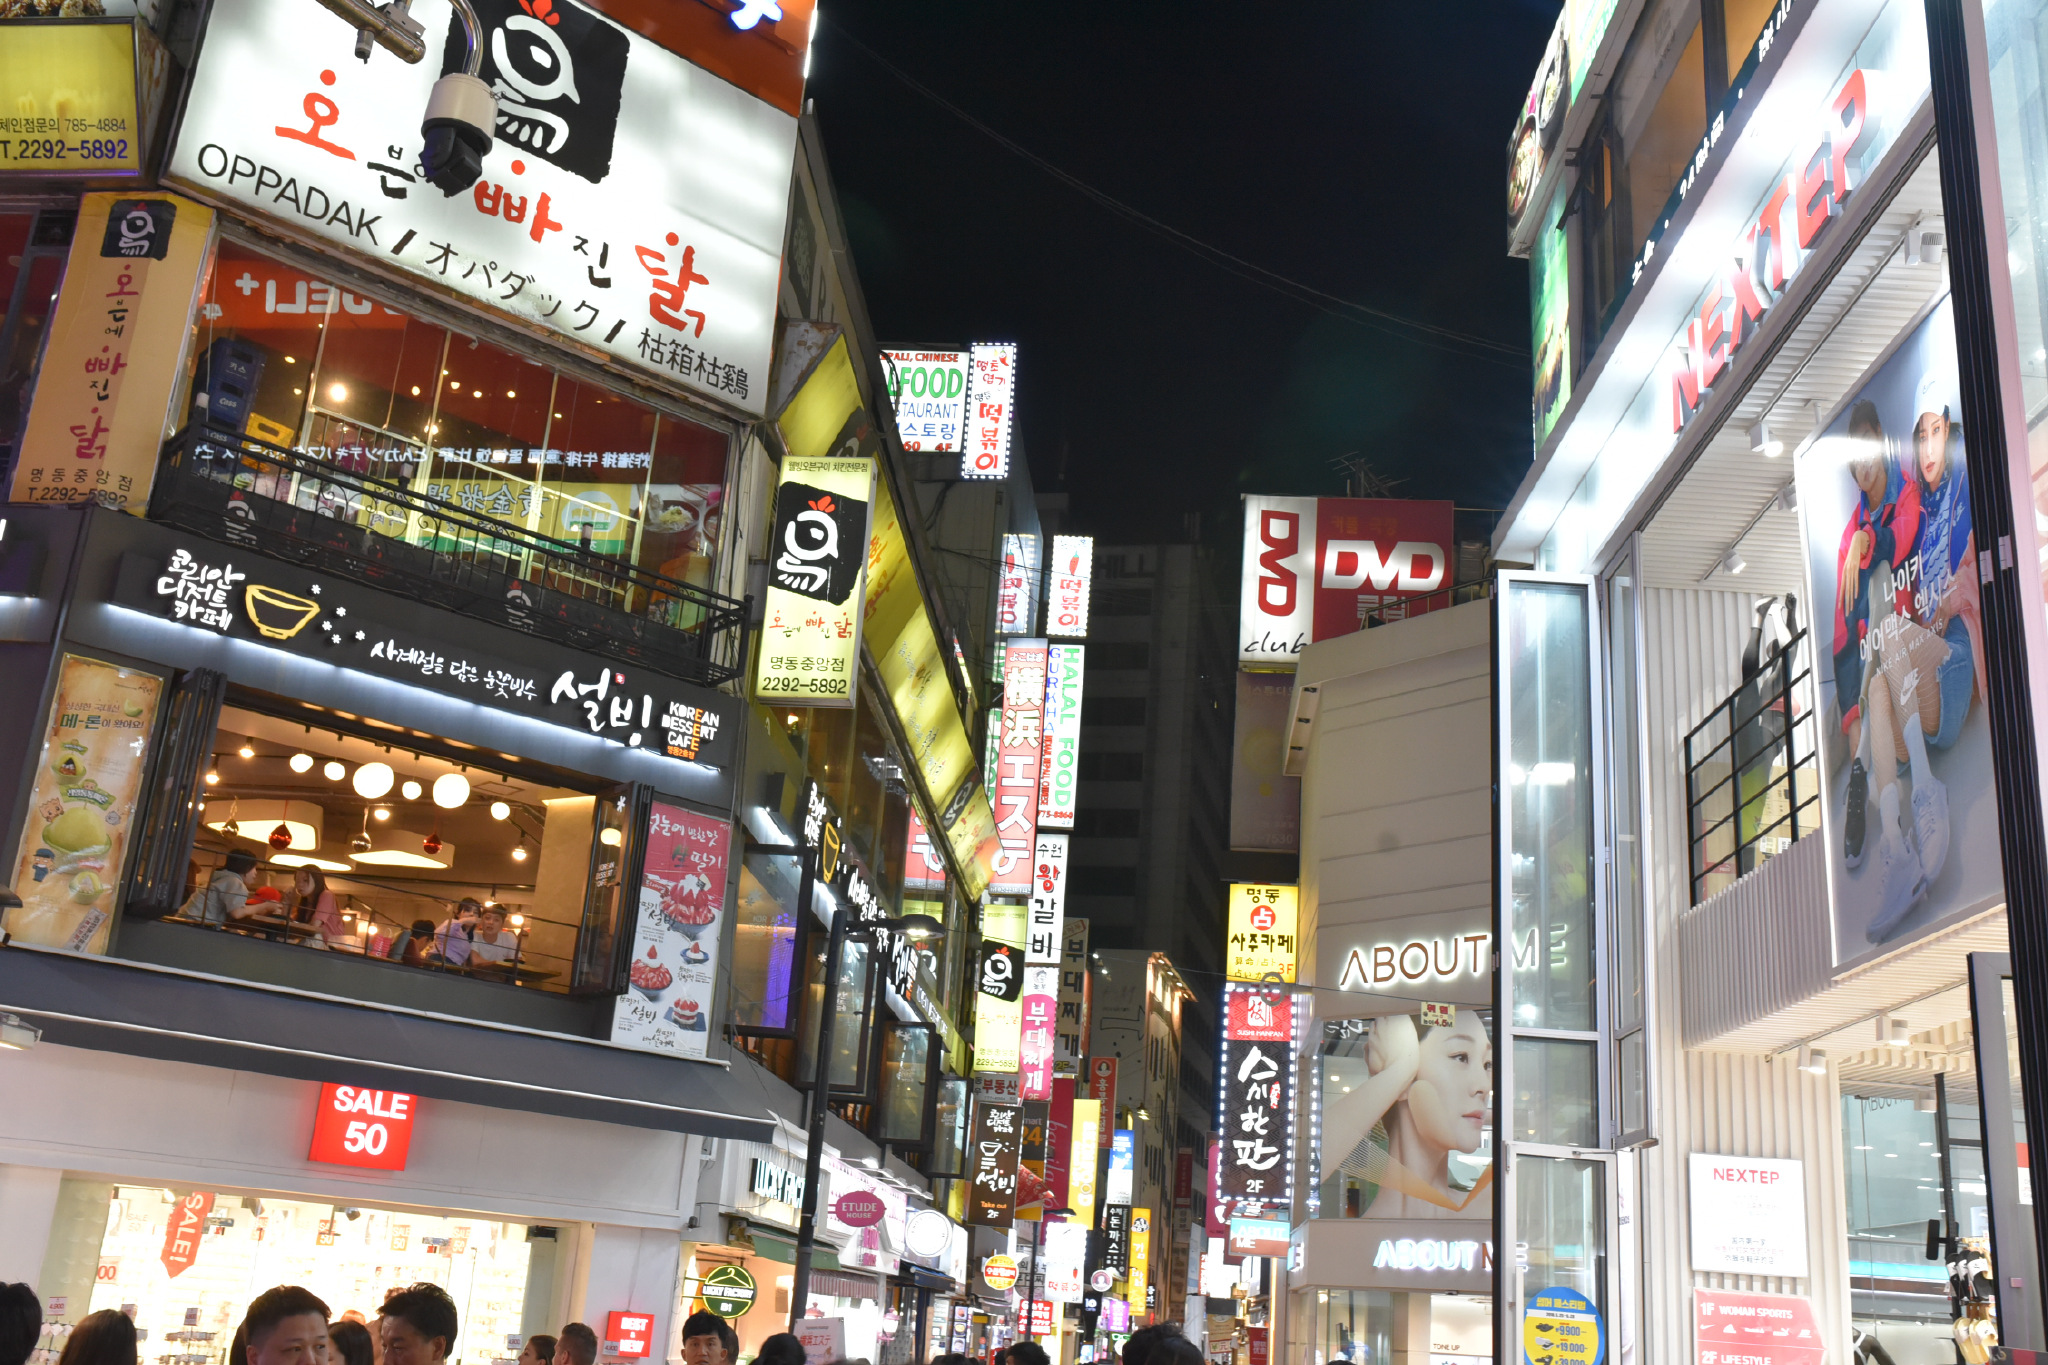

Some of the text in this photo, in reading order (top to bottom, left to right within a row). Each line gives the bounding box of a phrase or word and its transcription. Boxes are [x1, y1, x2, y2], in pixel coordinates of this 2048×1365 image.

[64, 119, 127, 133] 785-4884
[0, 139, 128, 161] T.2292-5892
[197, 143, 383, 246] OPPADAK
[1672, 69, 1867, 434] NEXTEP
[425, 241, 600, 332] オパダック
[915, 353, 959, 362] CHINESE
[975, 402, 1003, 471] 떡볶이
[168, 548, 246, 591] 코리안
[1258, 510, 1300, 617] DVD
[1321, 539, 1446, 591] DVD
[1882, 549, 1924, 604] 나이키
[157, 577, 228, 609] 디저트
[174, 599, 233, 631] 카페
[1859, 569, 1957, 662] 에어맥스 엑시스
[1244, 631, 1309, 654] club
[370, 639, 444, 675] 사계절을
[450, 660, 480, 683] 담은
[770, 656, 844, 672] 명동중앙점
[762, 677, 847, 694] 2292-5892
[1043, 647, 1061, 733] GURKHA
[550, 668, 653, 747] 설빙
[669, 701, 720, 727] KOREAN
[661, 713, 718, 740] DESSERT
[668, 731, 700, 751] CAFE
[1055, 648, 1080, 807] HALAL FOOD
[1037, 843, 1062, 859] 수원
[1032, 864, 1060, 959] 왕갈비
[1247, 888, 1280, 904] 명동
[1230, 933, 1294, 954] 사주카페
[1278, 963, 1294, 975] 3F
[1340, 934, 1488, 988] ABOUT
[1058, 938, 1084, 1058] 부대찌개
[1022, 1002, 1049, 1091] 부대찌개
[976, 1058, 1017, 1068] 2292-5892
[982, 1079, 1018, 1094] 부동산
[333, 1086, 410, 1120] SALE
[344, 1122, 388, 1156] 50
[1246, 1180, 1265, 1192] 2F
[1713, 1168, 1780, 1184] NEXTEP
[841, 1203, 878, 1212] ETUDE
[987, 1209, 999, 1219] 2F
[169, 1193, 204, 1264] SALE!
[1373, 1239, 1480, 1273] ABOUT
[621, 1317, 649, 1331] BEST
[1700, 1302, 1793, 1319] 1F WOMAN SPORTS
[1701, 1351, 1718, 1365] 2F
